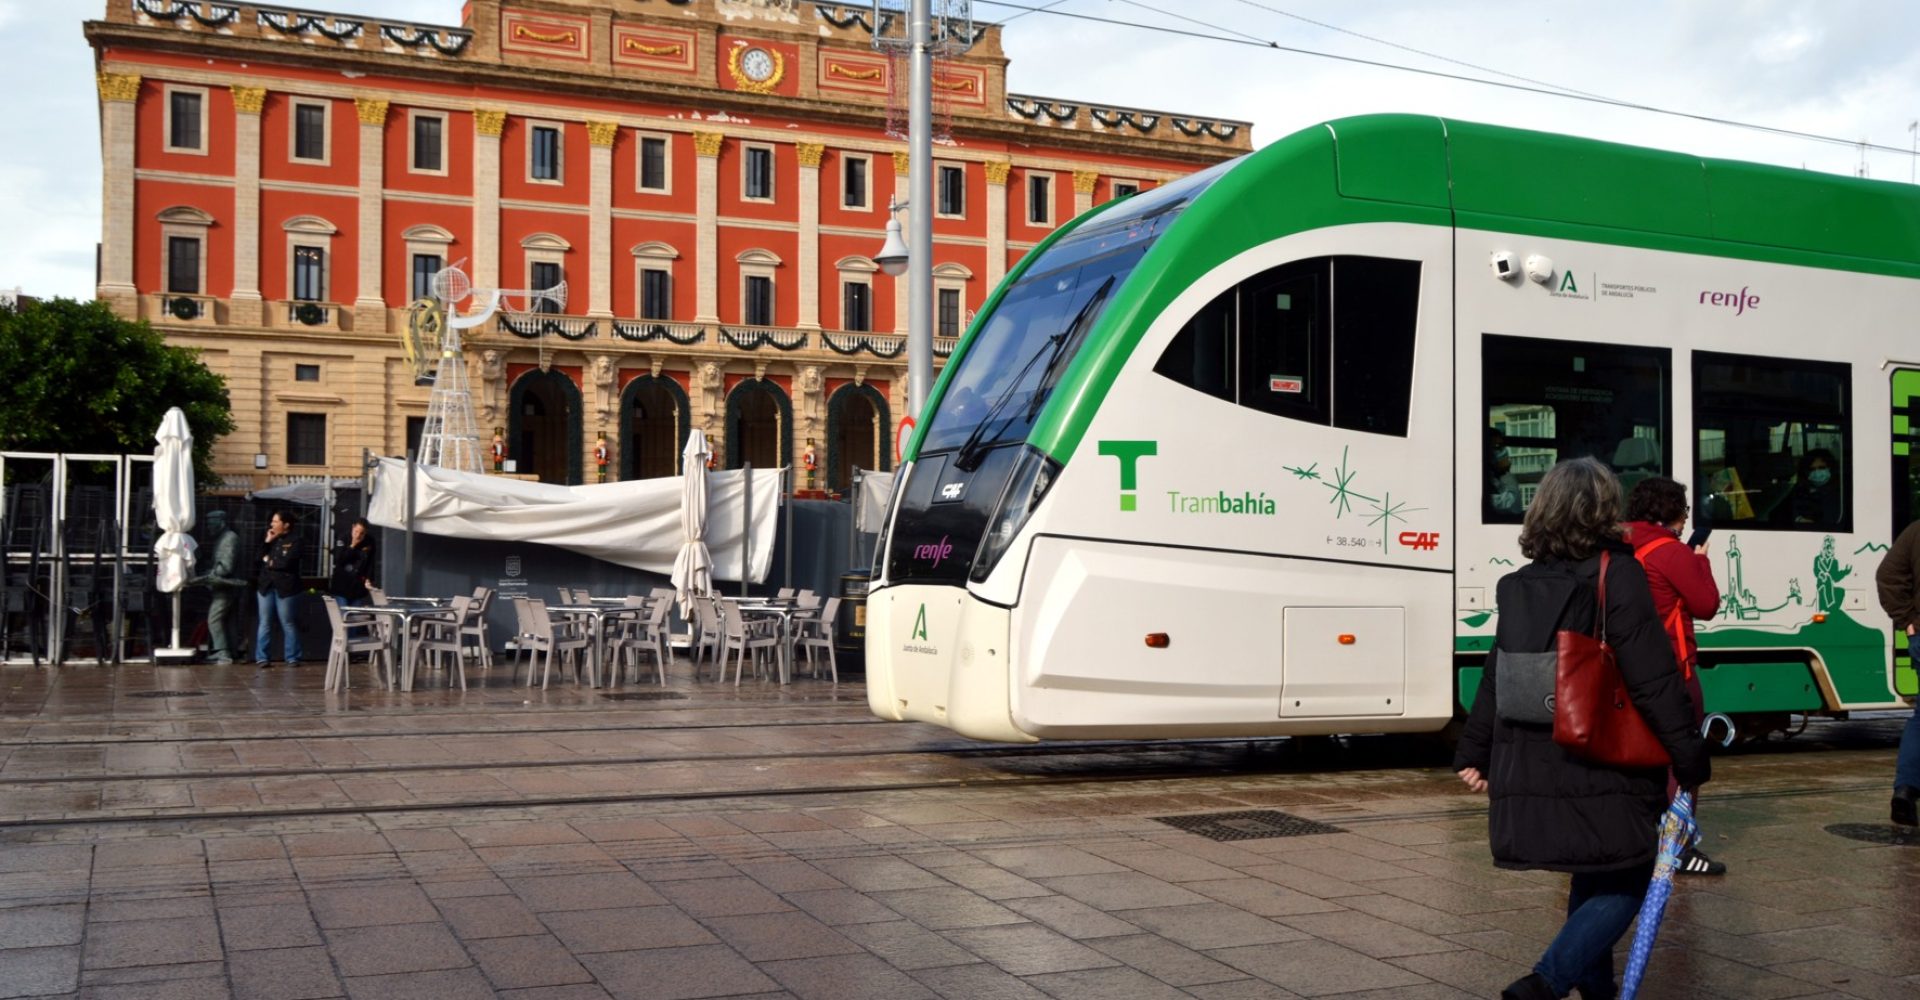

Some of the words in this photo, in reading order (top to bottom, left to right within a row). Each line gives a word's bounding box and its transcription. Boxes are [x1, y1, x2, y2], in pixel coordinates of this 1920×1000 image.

[1699, 286, 1760, 317] renfe
[1167, 491, 1276, 515] Trambahía
[914, 535, 953, 569] renfe
[1336, 536, 1367, 548] 38.540
[1398, 531, 1440, 551] CAF
